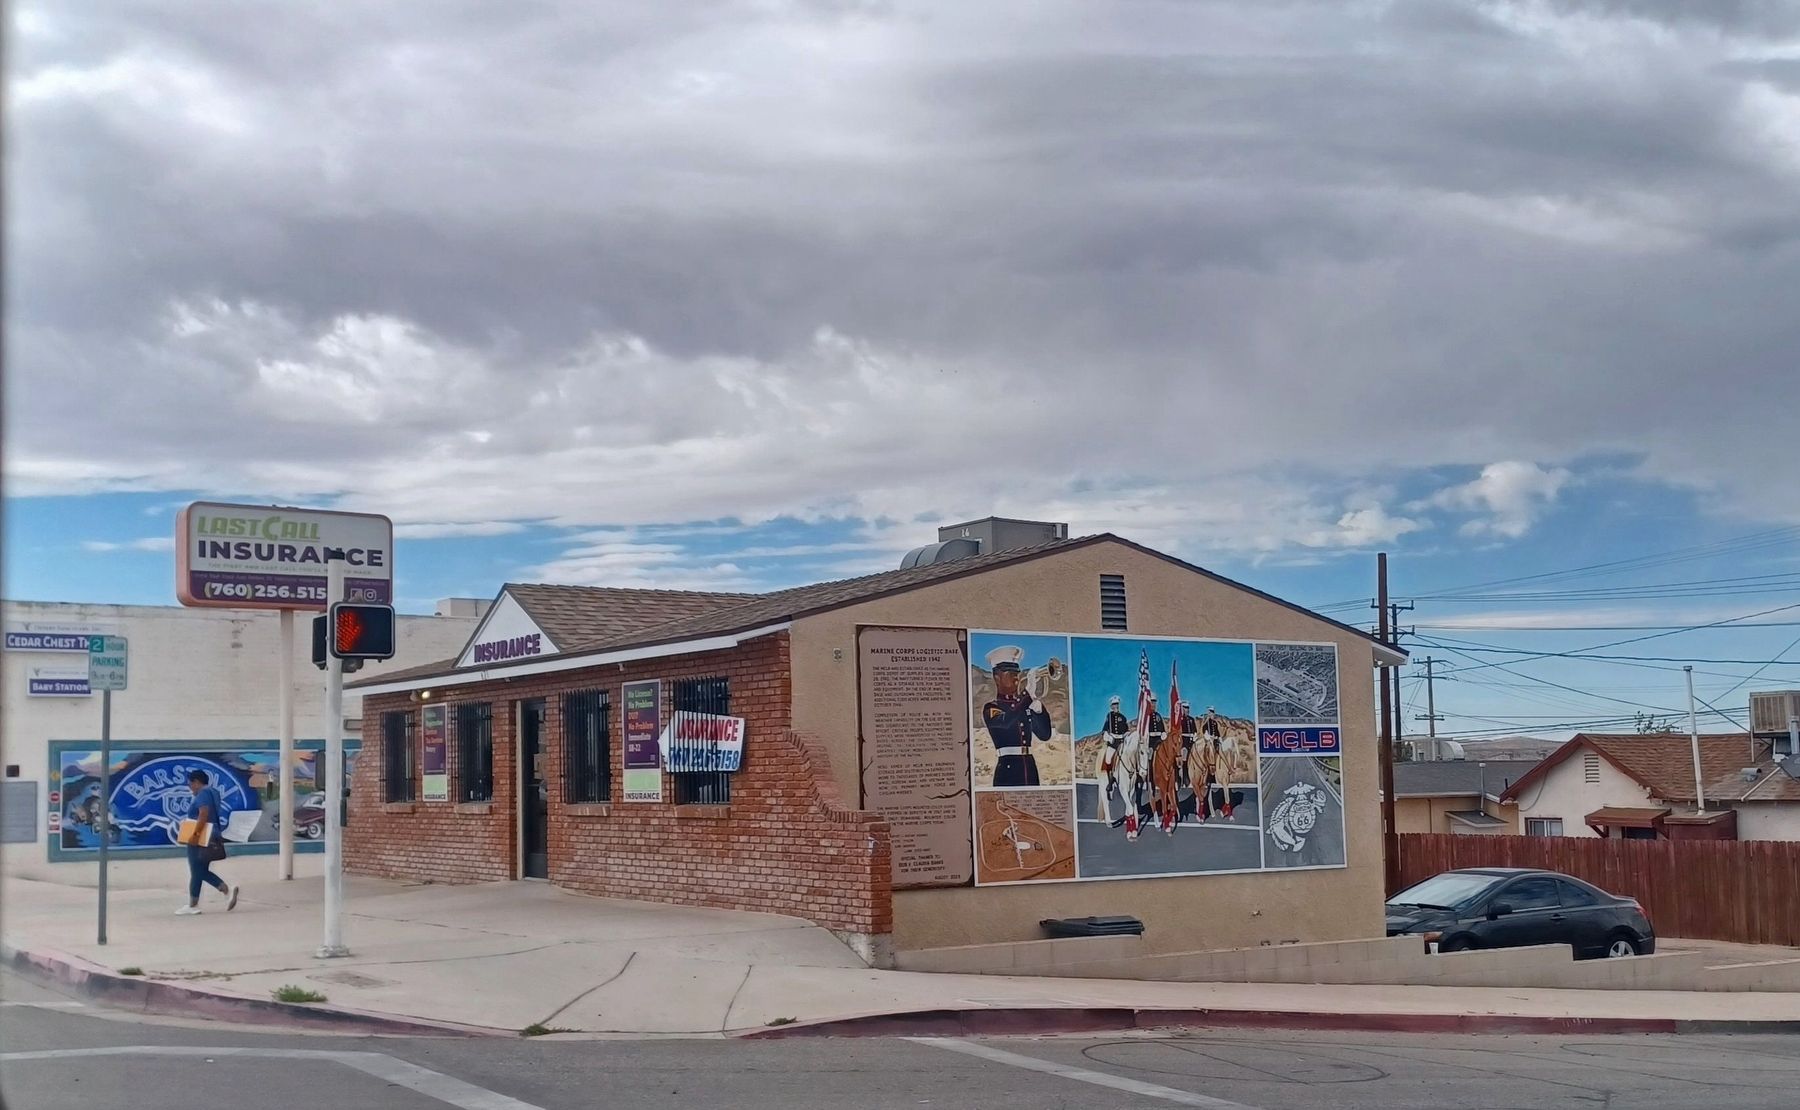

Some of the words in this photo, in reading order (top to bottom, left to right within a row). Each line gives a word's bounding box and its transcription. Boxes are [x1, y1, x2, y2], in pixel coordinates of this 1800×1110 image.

[204, 581, 252, 600] (760)
[255, 585, 327, 600] 256.515
[7, 634, 41, 648] CEDAR
[43, 636, 76, 649] CHEST
[92, 639, 102, 651] 2
[474, 633, 541, 663] INSURANCE
[91, 655, 125, 667] PARKING
[32, 682, 53, 691] BABY
[55, 682, 88, 692] STATION
[1262, 730, 1336, 750] MCLB
[124, 765, 239, 800] BARSW
[1297, 815, 1309, 826] 66
